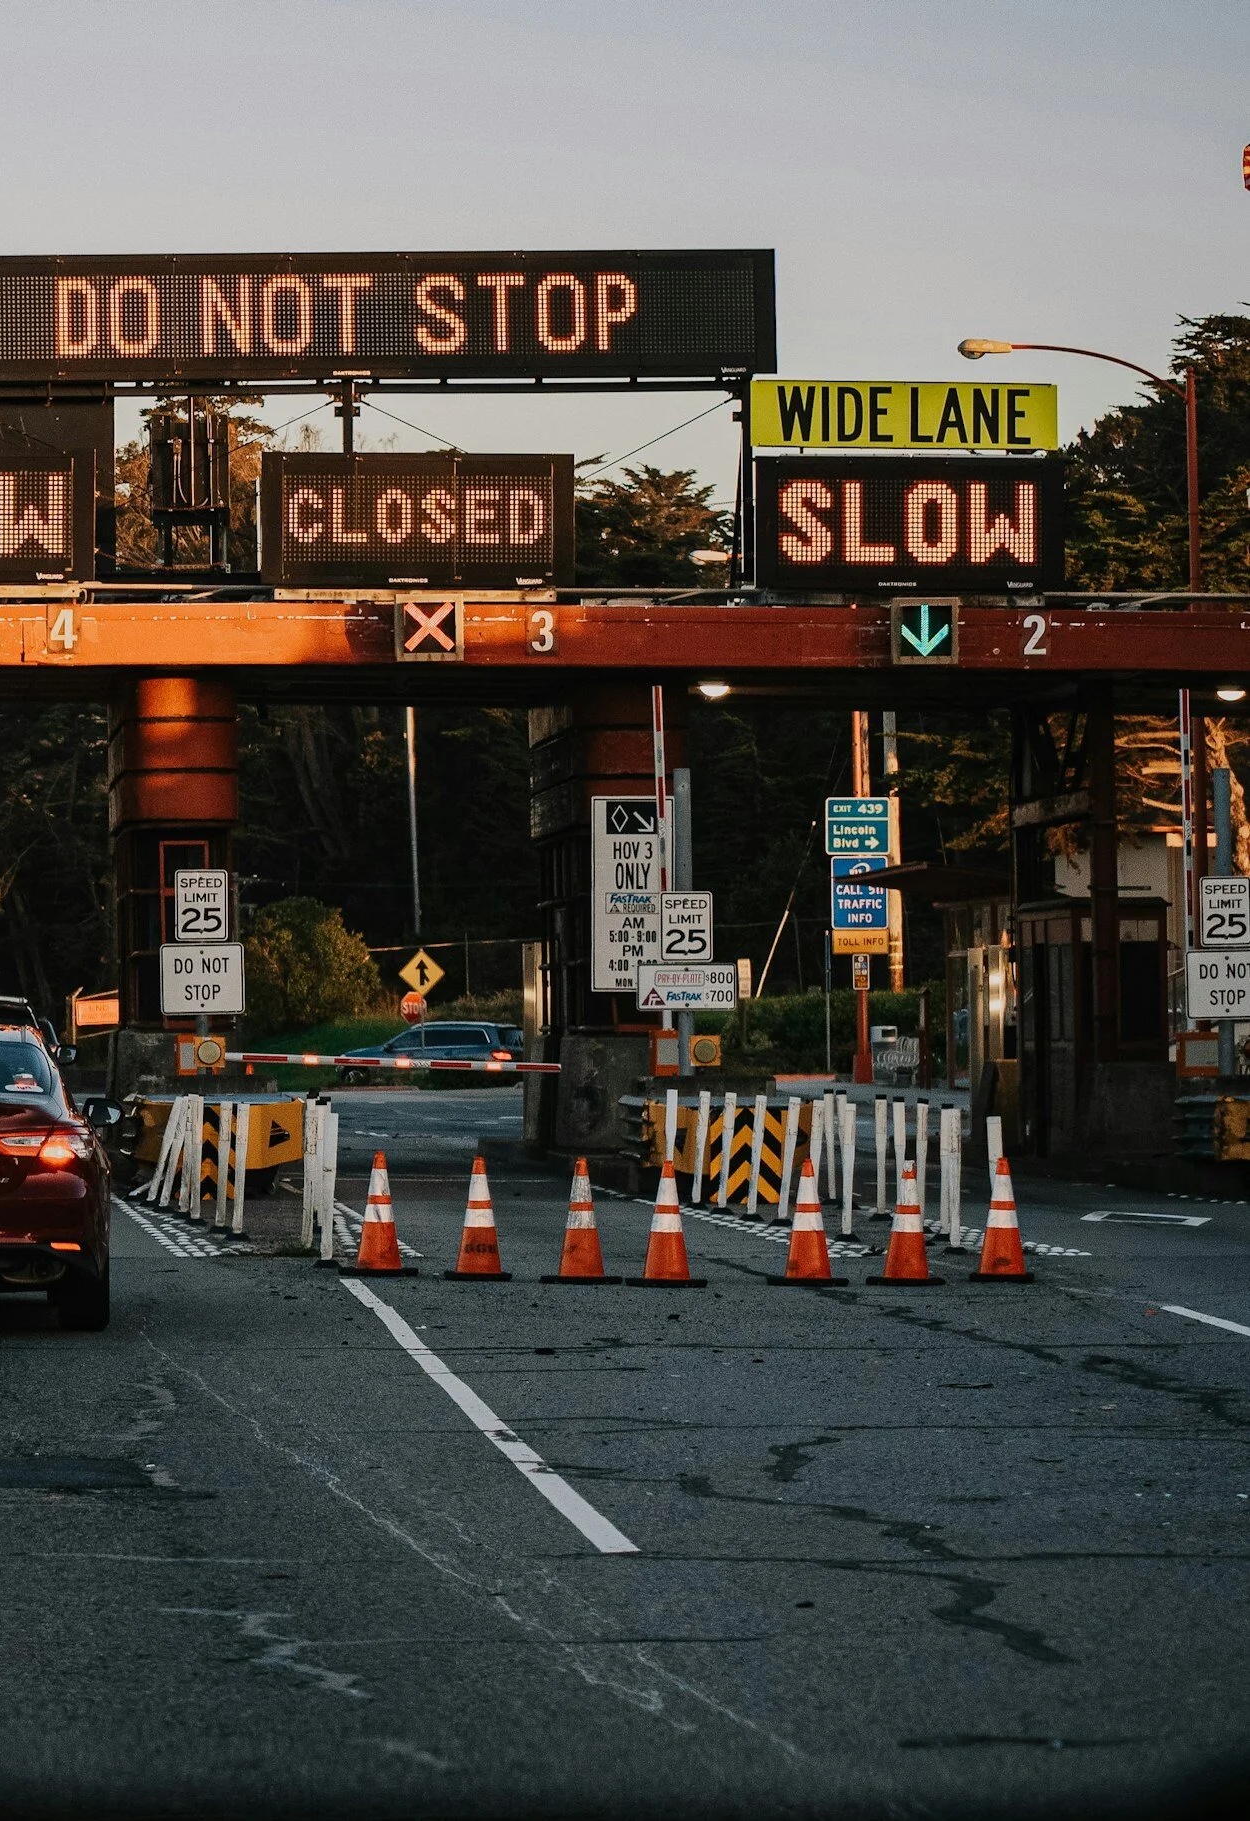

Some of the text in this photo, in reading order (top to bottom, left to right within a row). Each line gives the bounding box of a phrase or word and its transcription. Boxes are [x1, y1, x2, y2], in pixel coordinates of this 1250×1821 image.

[58, 274, 635, 354] DO NOT STOP
[777, 386, 1032, 445] WIDE LANE
[288, 489, 544, 544] CLOSED
[782, 482, 1034, 563] SLOW
[50, 609, 78, 649] 4
[531, 611, 554, 652] 3
[1023, 615, 1047, 655] 2
[833, 804, 884, 814] EXIT 439
[833, 825, 877, 835] Lincoln
[833, 838, 859, 848] Blvd
[613, 842, 653, 859] HOV 3
[615, 863, 651, 889] ONLY
[180, 878, 222, 888] SPEED
[836, 885, 863, 895] CALL
[1205, 884, 1247, 895] SPEED
[184, 893, 218, 902] LIMIT
[623, 904, 656, 912] REQUIRED
[665, 900, 707, 909] SPEED
[838, 899, 882, 909] TRAFFIC
[1209, 900, 1242, 909] LIMIT
[181, 908, 222, 933] 25
[622, 917, 645, 929] AM
[669, 915, 703, 924] LIMIT
[848, 913, 872, 923] INFO
[1206, 914, 1247, 939] 25
[609, 931, 629, 942] 5:00
[637, 931, 657, 942] 9:00
[665, 929, 707, 954] 25
[838, 937, 884, 946] TOLL INFO
[622, 945, 644, 957] PM
[174, 958, 229, 974] DO NOT
[609, 960, 629, 971] 4:00
[1200, 964, 1218, 979] DO
[615, 979, 633, 987] MON
[657, 974, 702, 983] PAY-BY-PLATE
[185, 985, 220, 1000] STOP
[1209, 990, 1246, 1005] STOP
